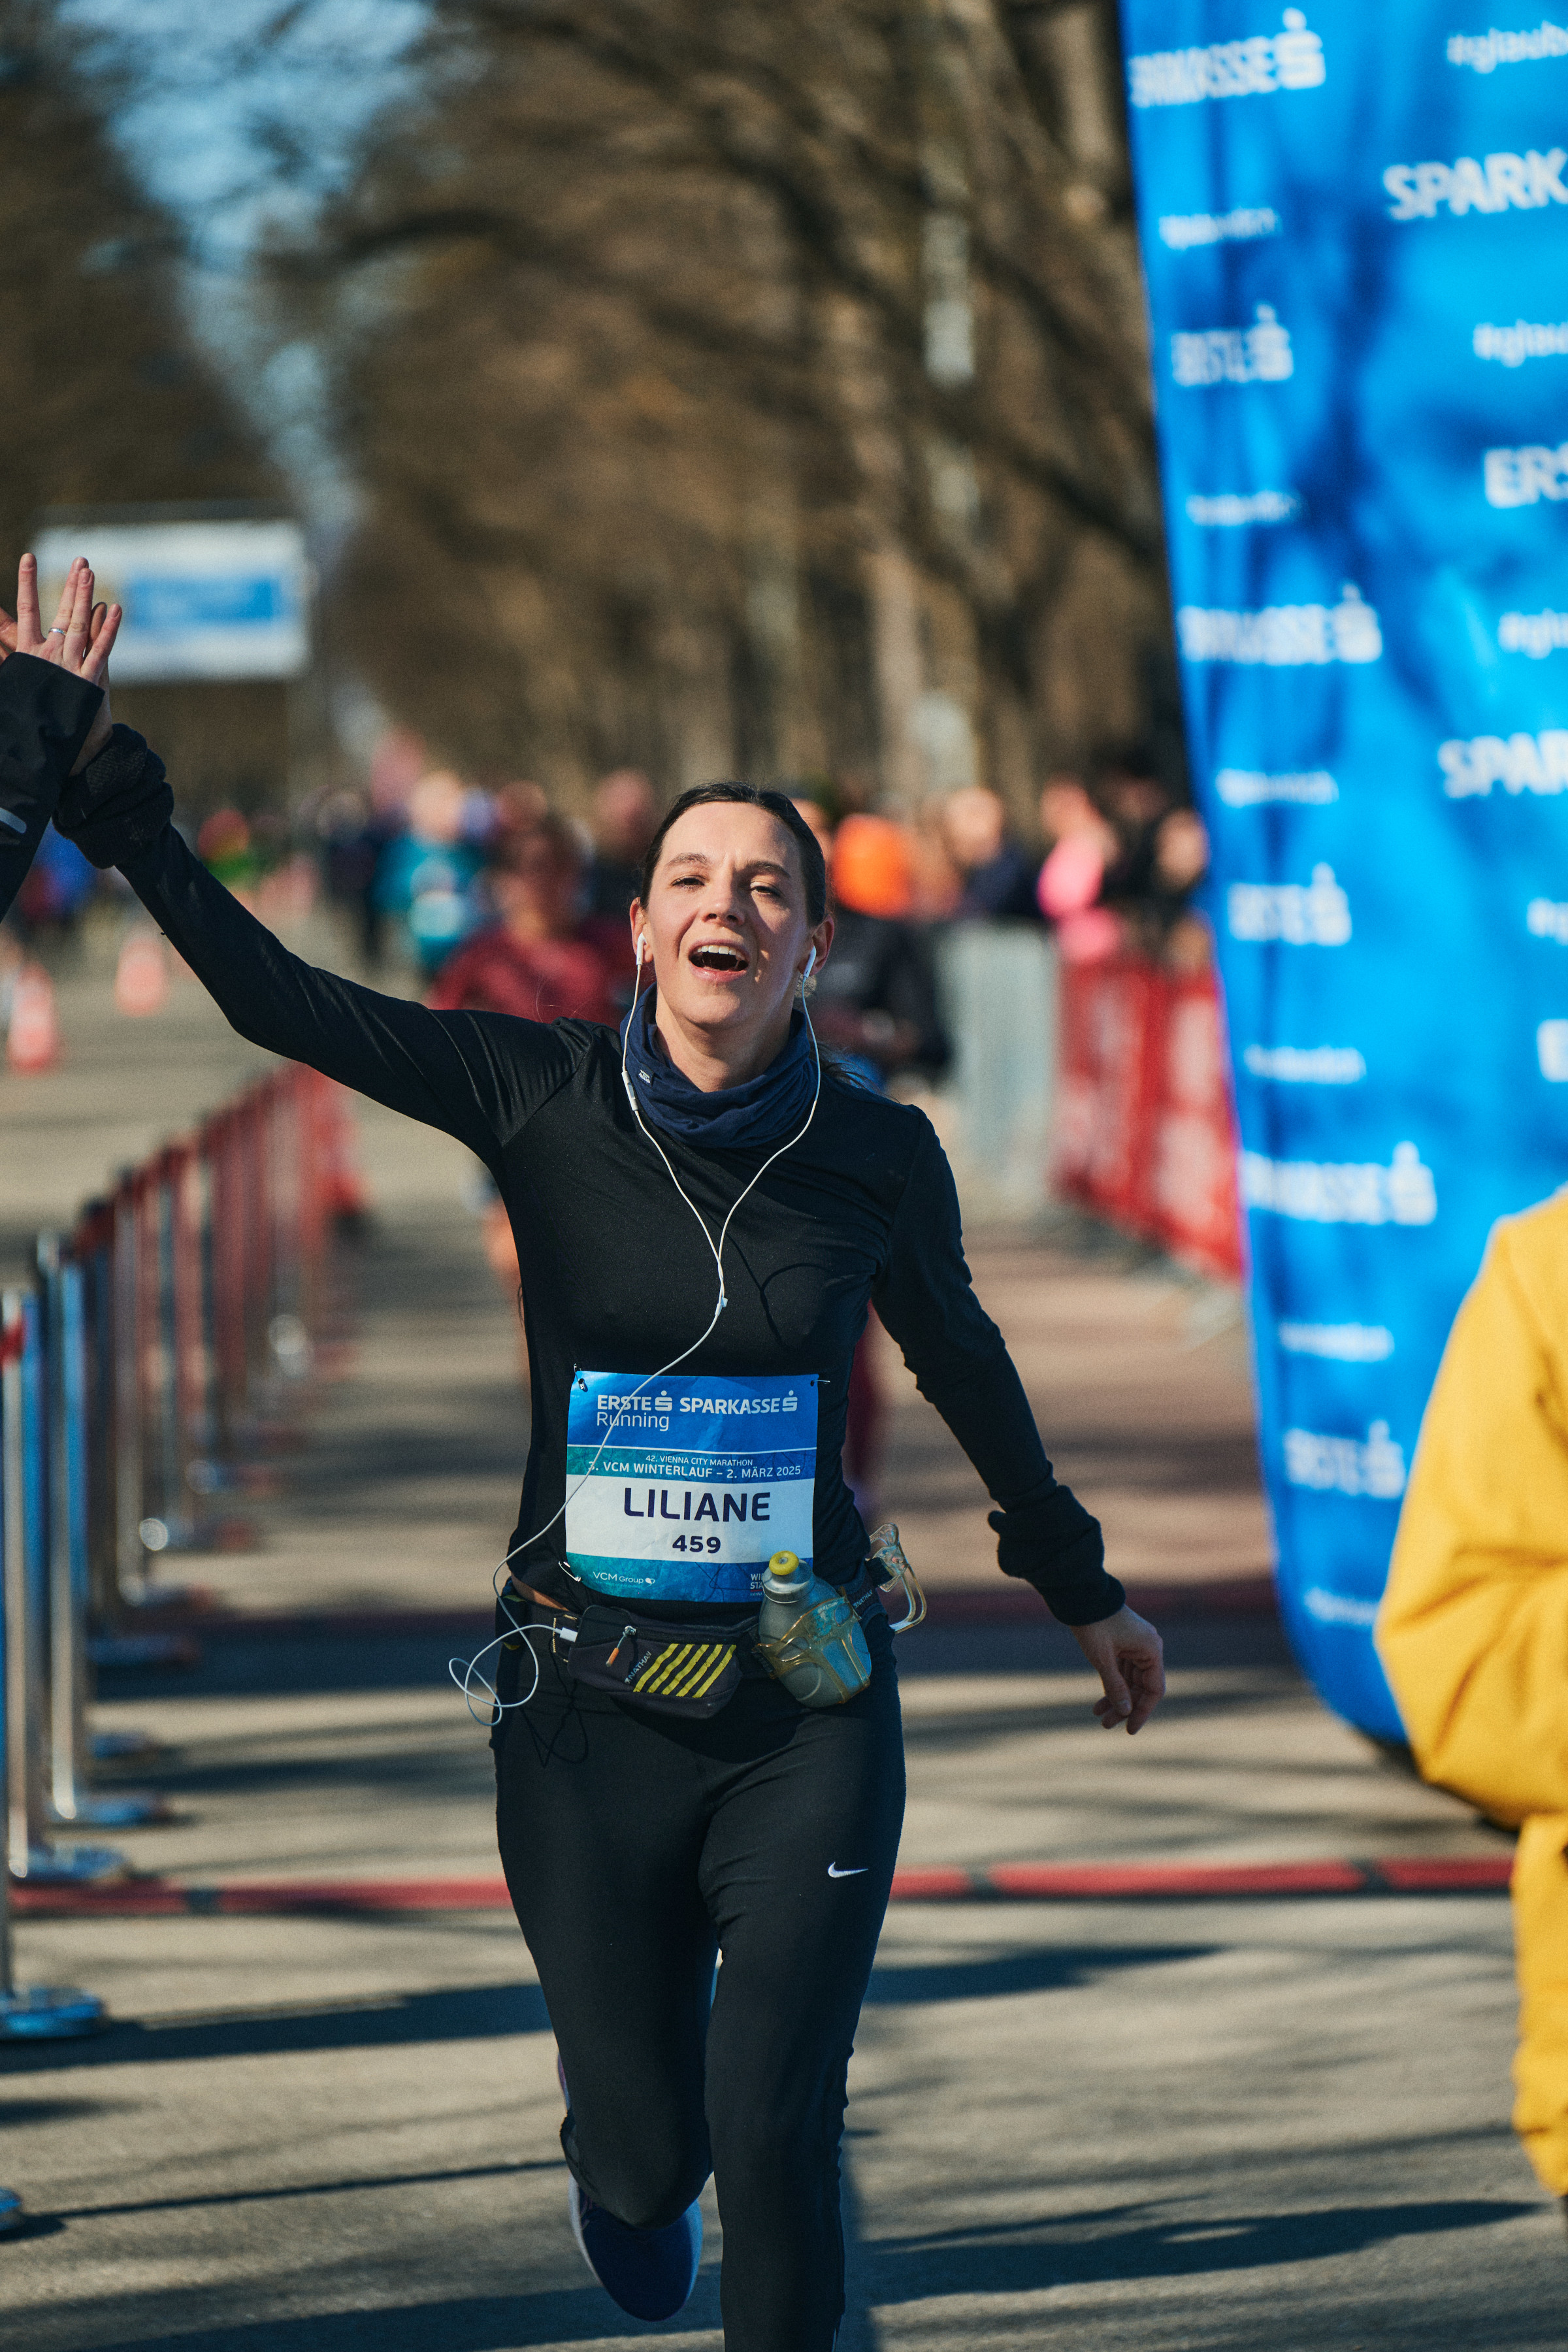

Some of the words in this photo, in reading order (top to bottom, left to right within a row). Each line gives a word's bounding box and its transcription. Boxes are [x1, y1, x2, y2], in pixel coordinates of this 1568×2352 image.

[1383, 148, 1568, 220] SPARK
[597, 1394, 652, 1411] ERSTE
[679, 1397, 781, 1414] SPARKASSE
[596, 1411, 669, 1431] Running
[588, 1461, 599, 1471] 3.
[603, 1462, 629, 1472] VCM
[633, 1463, 713, 1478] WINTERLAUF
[727, 1469, 738, 1478] 2.
[742, 1466, 774, 1478] MÄRZ
[776, 1465, 801, 1477] 2025
[660, 1456, 689, 1464] VIENNA
[691, 1457, 708, 1465] CITY
[624, 1487, 770, 1522] LILIANE
[672, 1535, 721, 1554] 459
[593, 1571, 617, 1581] VCM
[628, 1650, 652, 1680] NATHAN
